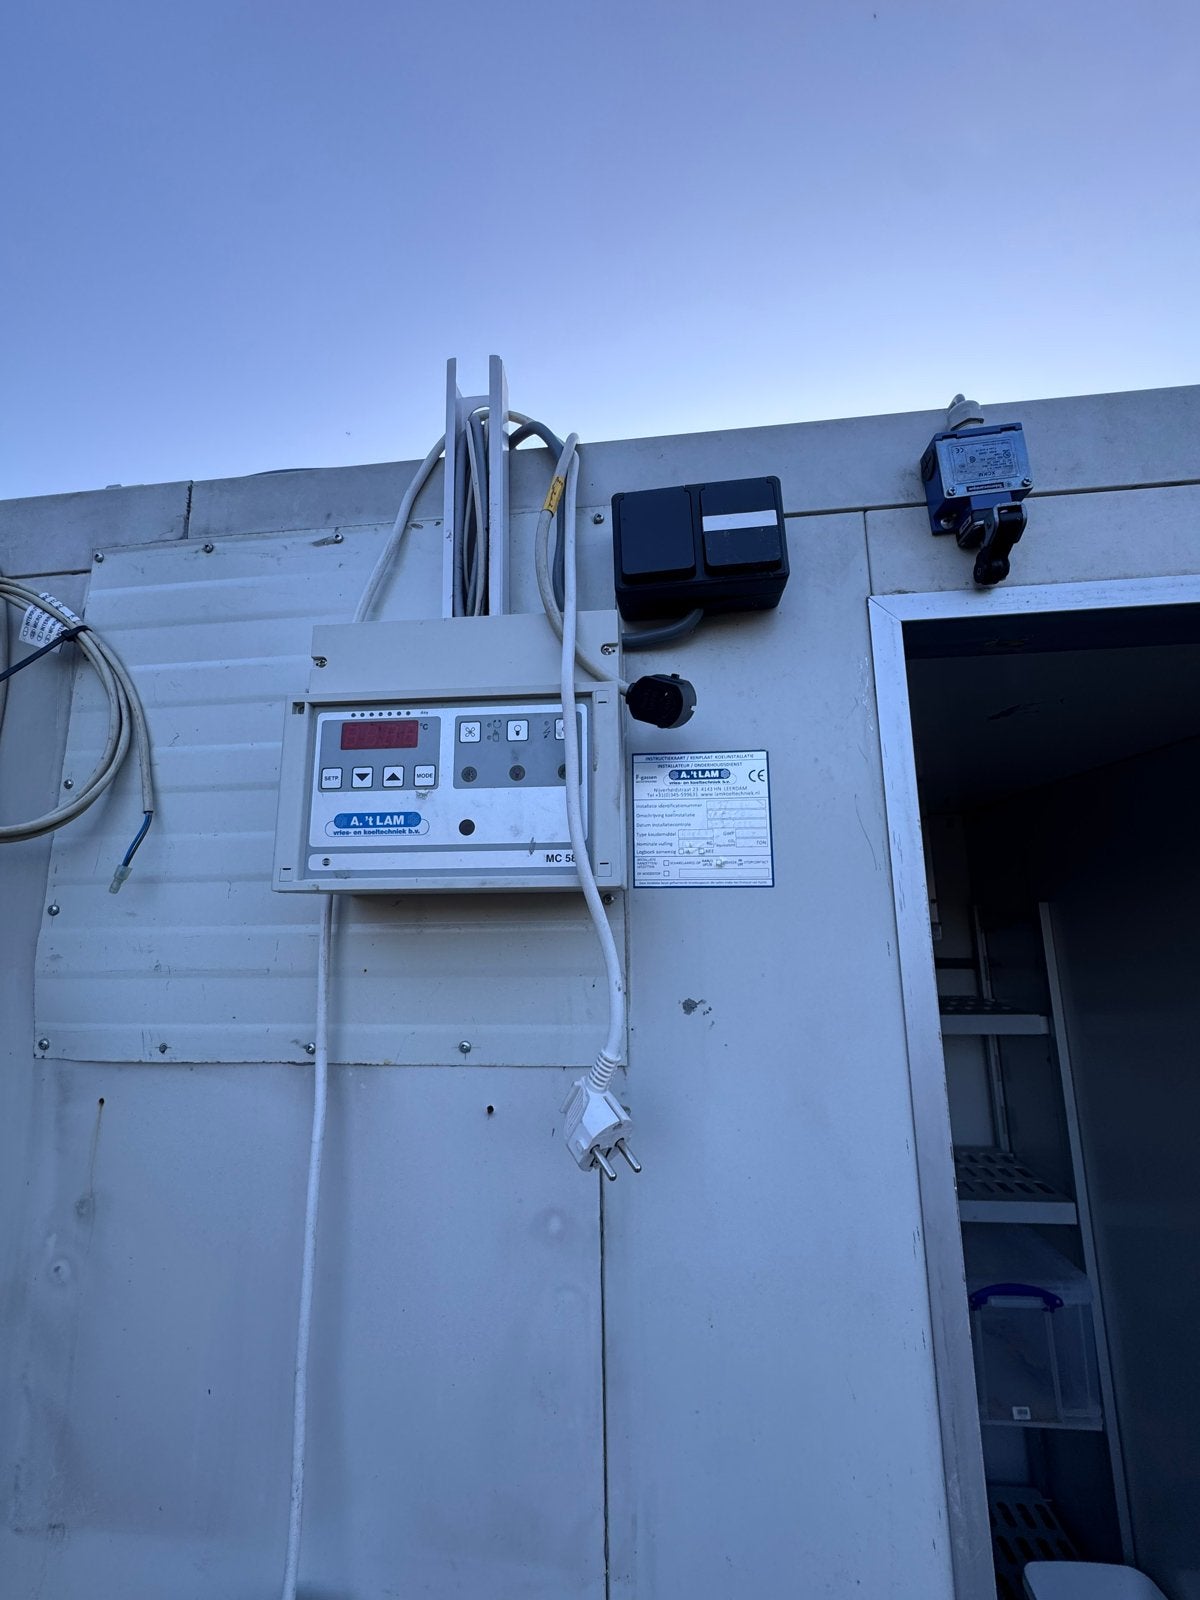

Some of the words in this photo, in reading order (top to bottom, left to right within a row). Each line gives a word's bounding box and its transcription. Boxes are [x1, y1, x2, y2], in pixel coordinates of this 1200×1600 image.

[680, 771, 690, 779] A.
[698, 770, 720, 778] LAM
[748, 769, 765, 782] CE
[350, 816, 363, 826] A.
[376, 815, 405, 826] LAM
[363, 828, 407, 836] koeltechniek
[546, 853, 562, 862] MC
